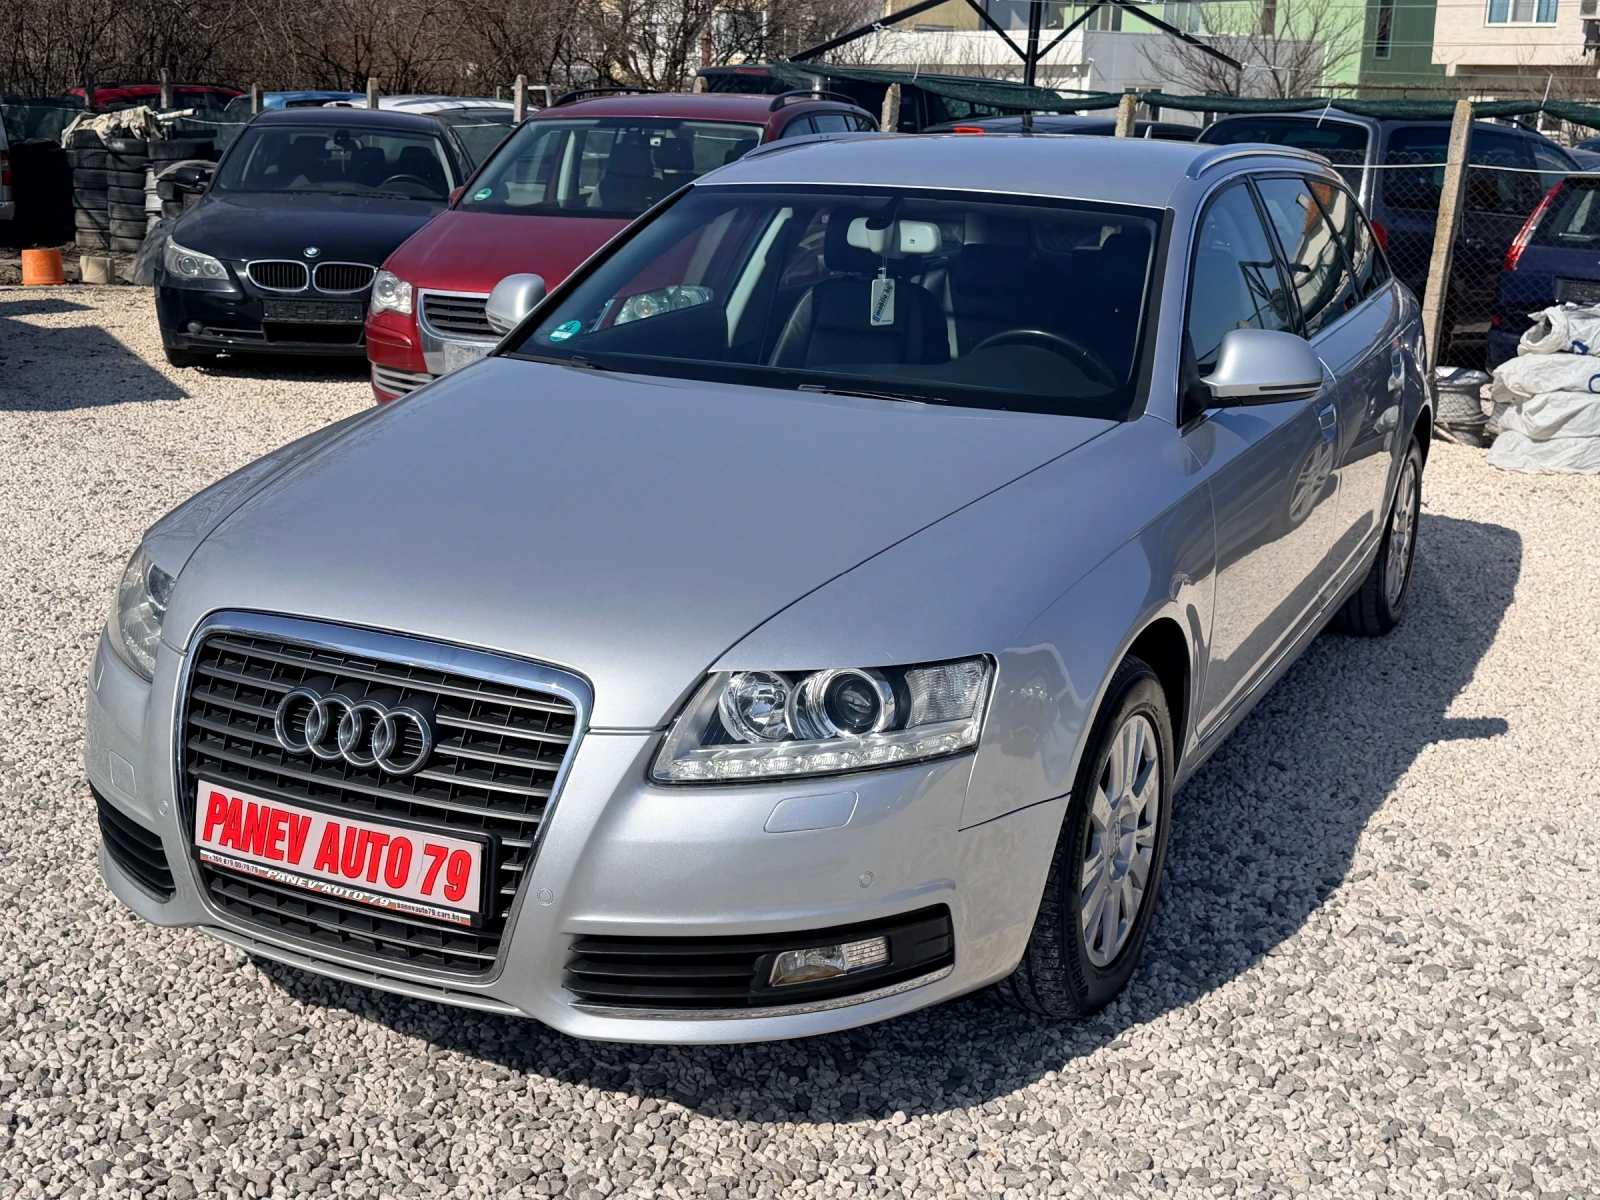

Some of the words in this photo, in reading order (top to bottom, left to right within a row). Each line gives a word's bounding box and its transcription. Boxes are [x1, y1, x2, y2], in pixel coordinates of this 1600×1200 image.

[202, 791, 312, 864] PANEV
[314, 821, 413, 889] AUTO
[420, 843, 472, 902] 79
[266, 868, 319, 889] PANEV
[320, 883, 364, 900] AUTO
[368, 893, 390, 907] 79
